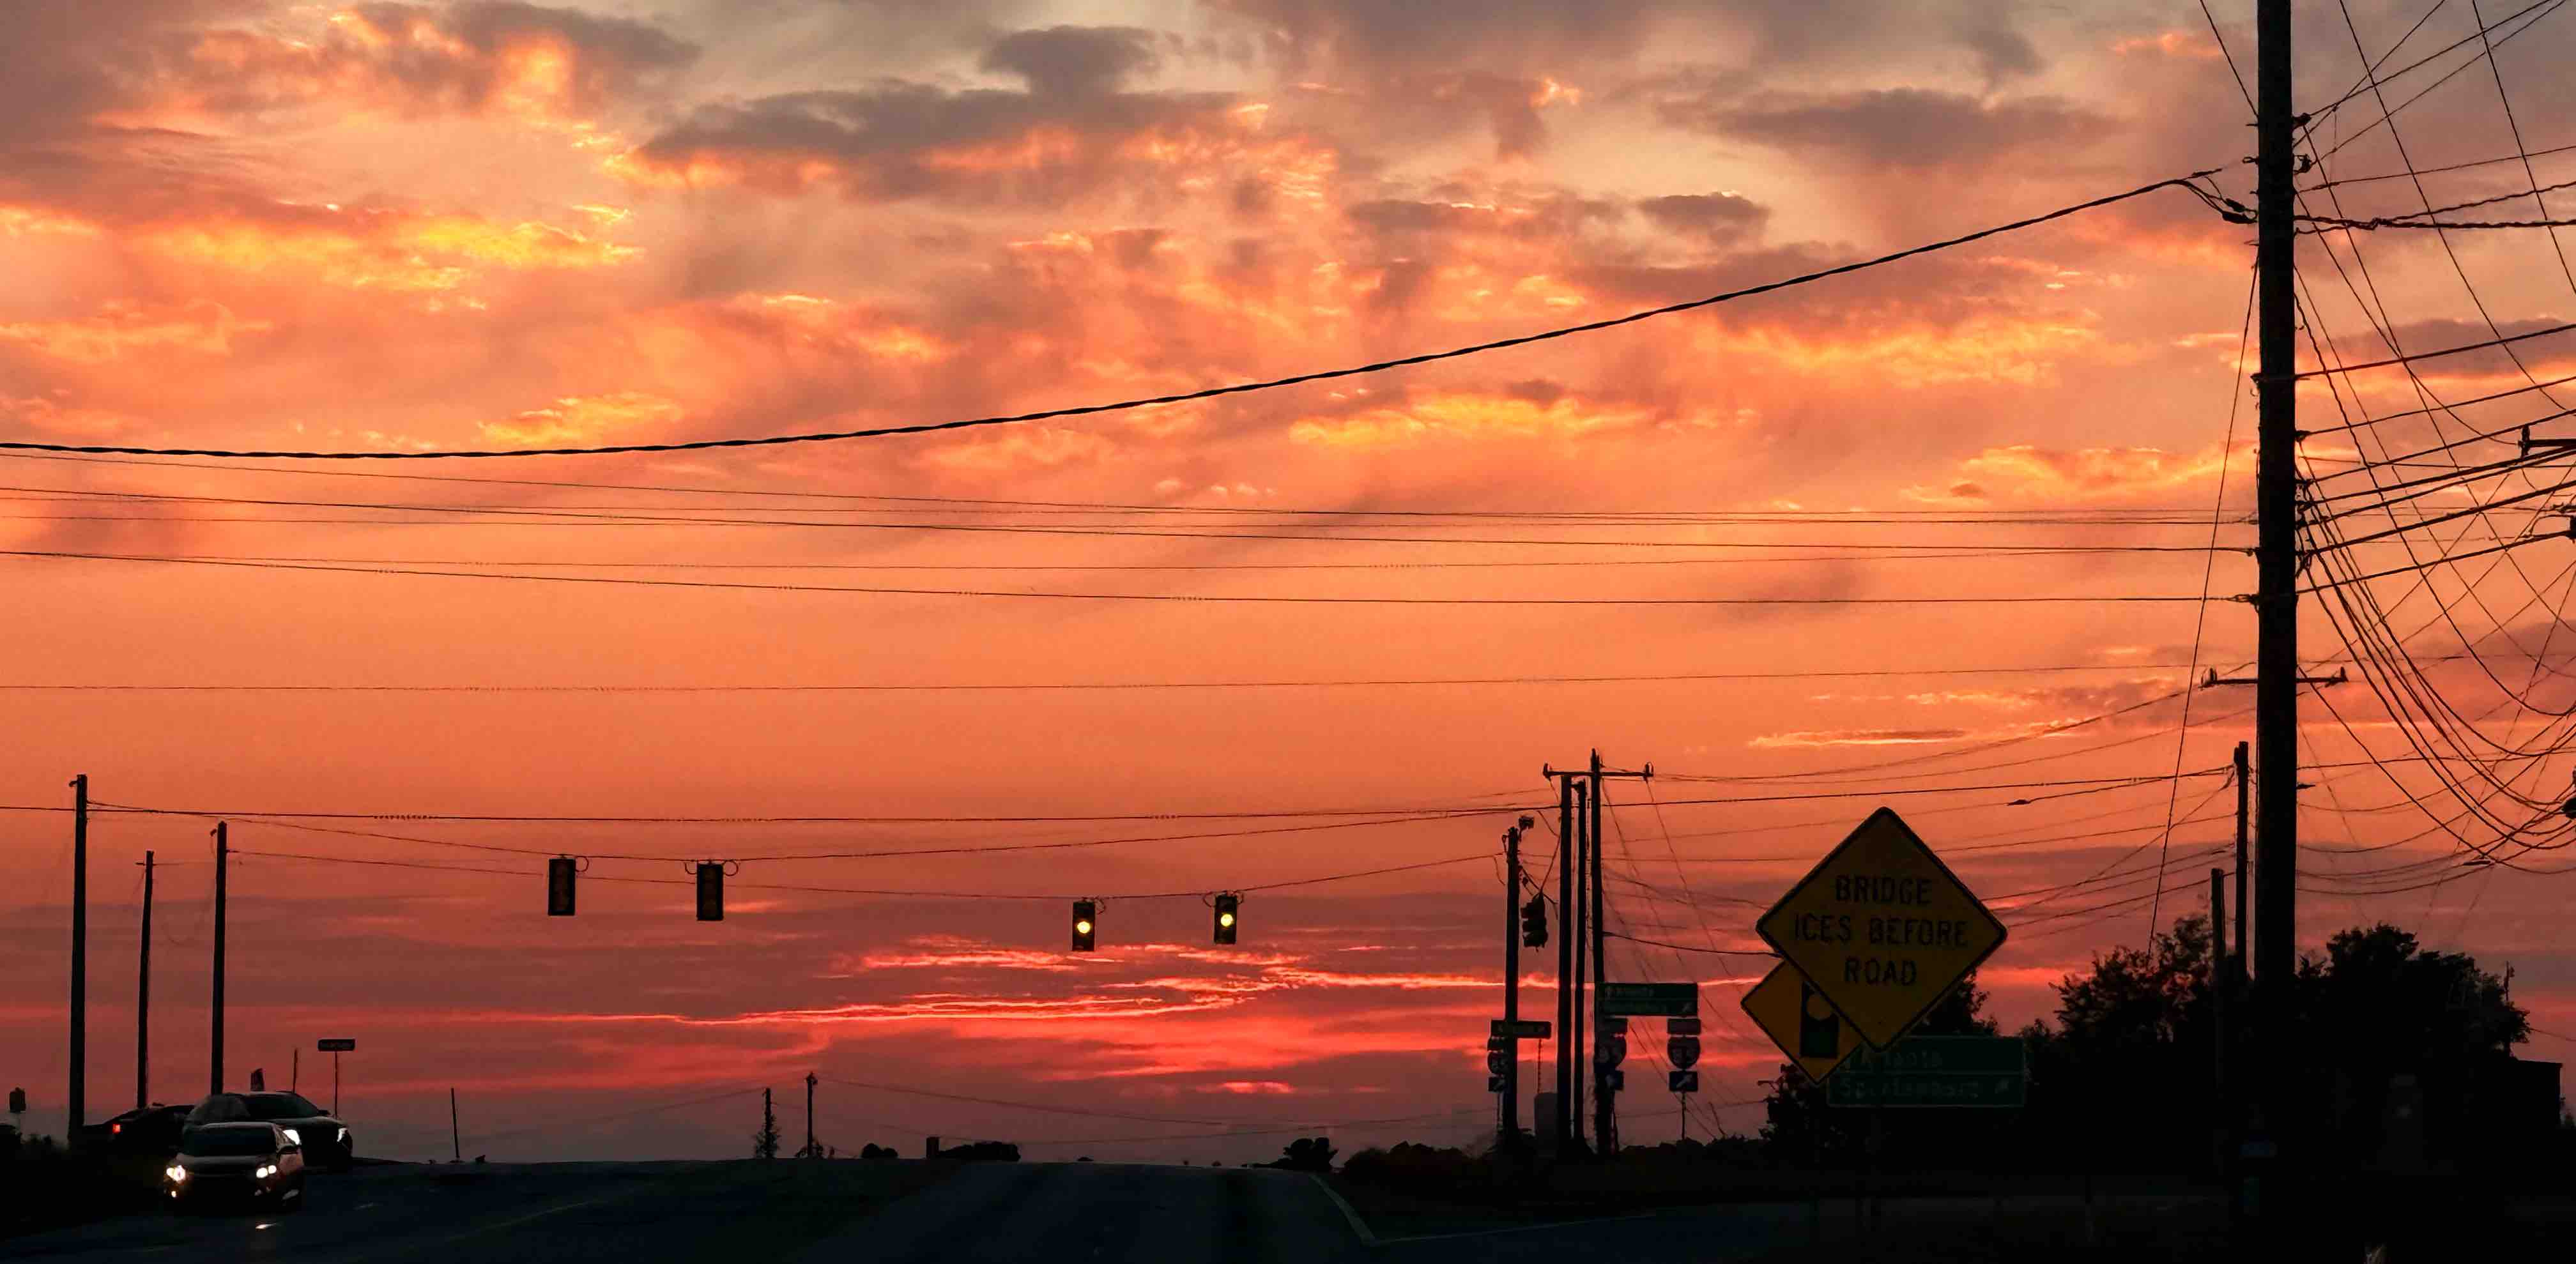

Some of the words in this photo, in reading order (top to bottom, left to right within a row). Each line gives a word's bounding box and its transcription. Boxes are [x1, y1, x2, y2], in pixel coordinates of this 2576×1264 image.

[1835, 874, 1932, 904] BRIDGE
[1794, 912, 1851, 942] ICES
[1870, 917, 1968, 947] BEFORE
[1844, 956, 1917, 986] ROAD
